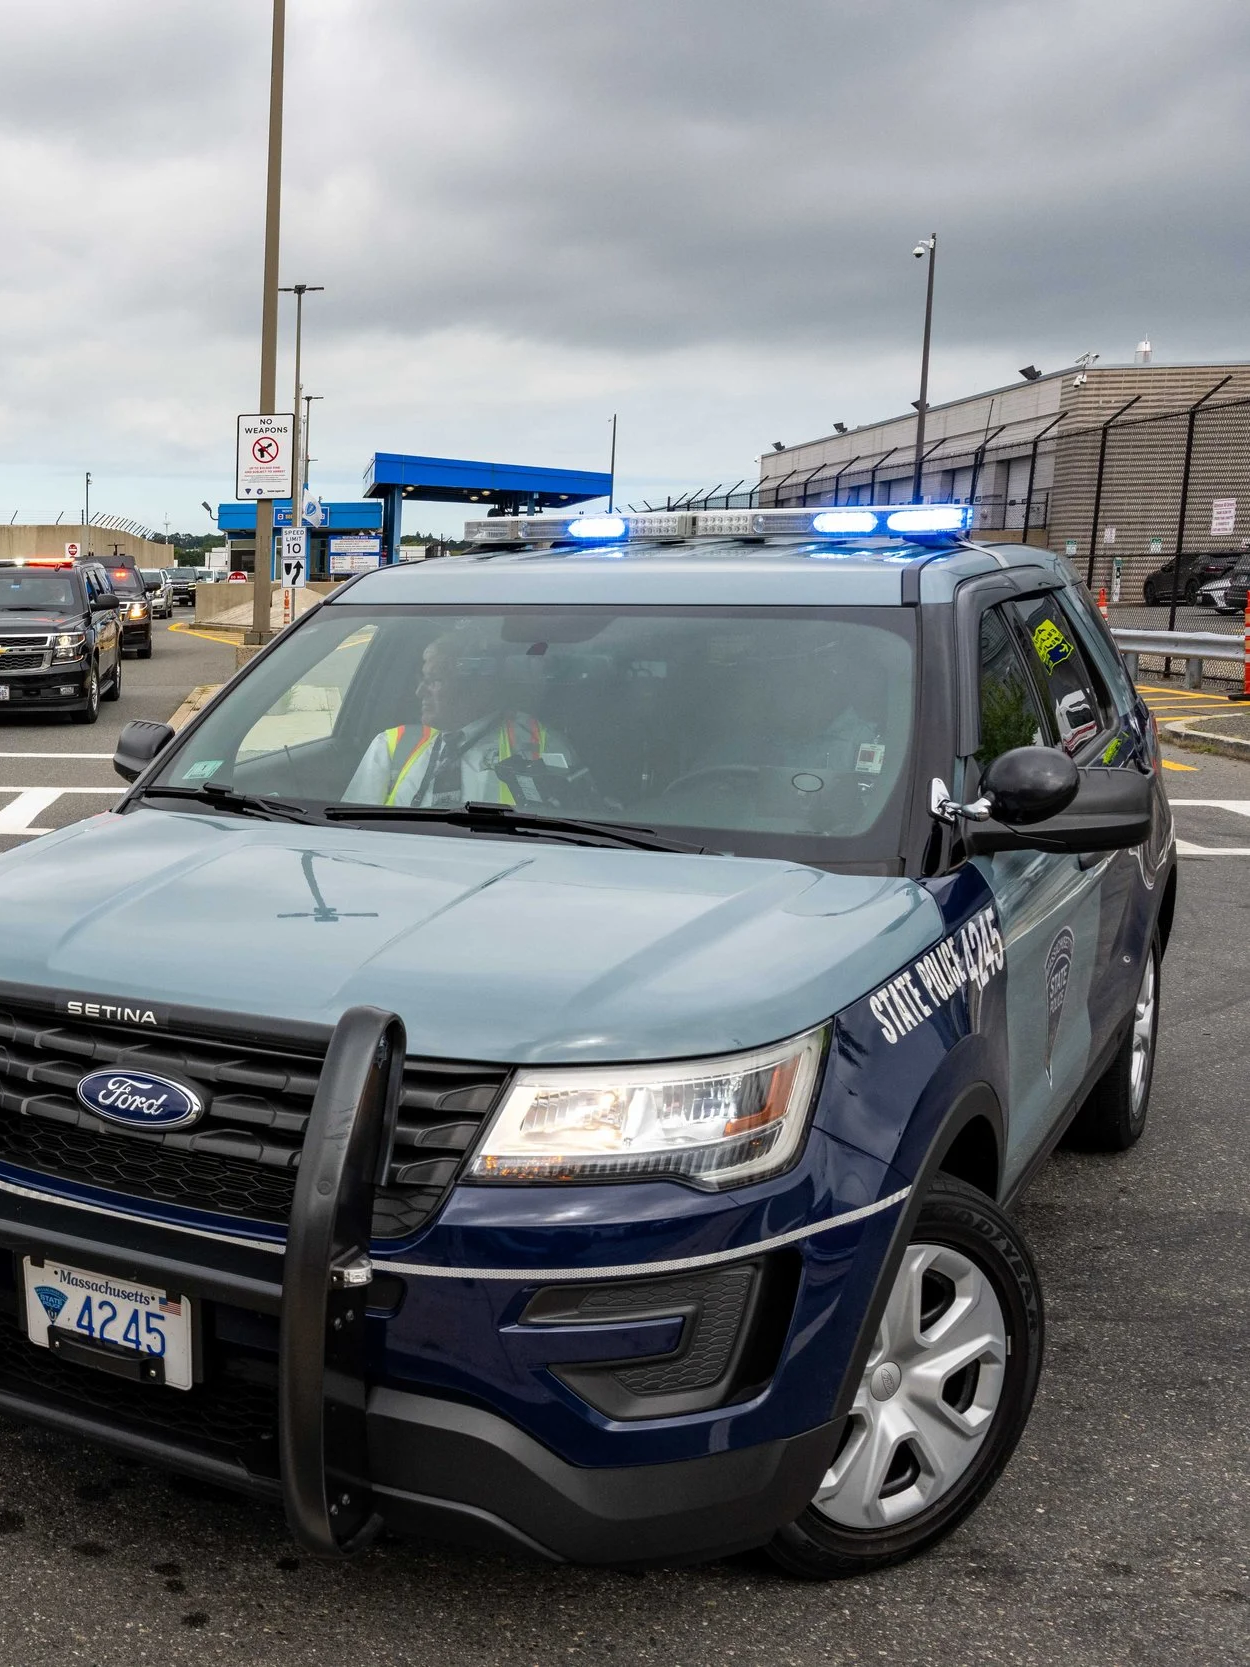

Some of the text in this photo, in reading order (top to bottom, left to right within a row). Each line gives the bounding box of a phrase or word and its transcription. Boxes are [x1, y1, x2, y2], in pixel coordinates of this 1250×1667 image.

[287, 543, 301, 554] 10
[869, 906, 1004, 1044] STATE POLICE 4245
[1050, 964, 1068, 999] STATE
[67, 1001, 157, 1025] SETINA
[98, 1077, 168, 1115] Ford
[40, 1294, 63, 1306] STATE
[60, 1270, 151, 1306] Massachusetts
[76, 1296, 165, 1358] 4245
